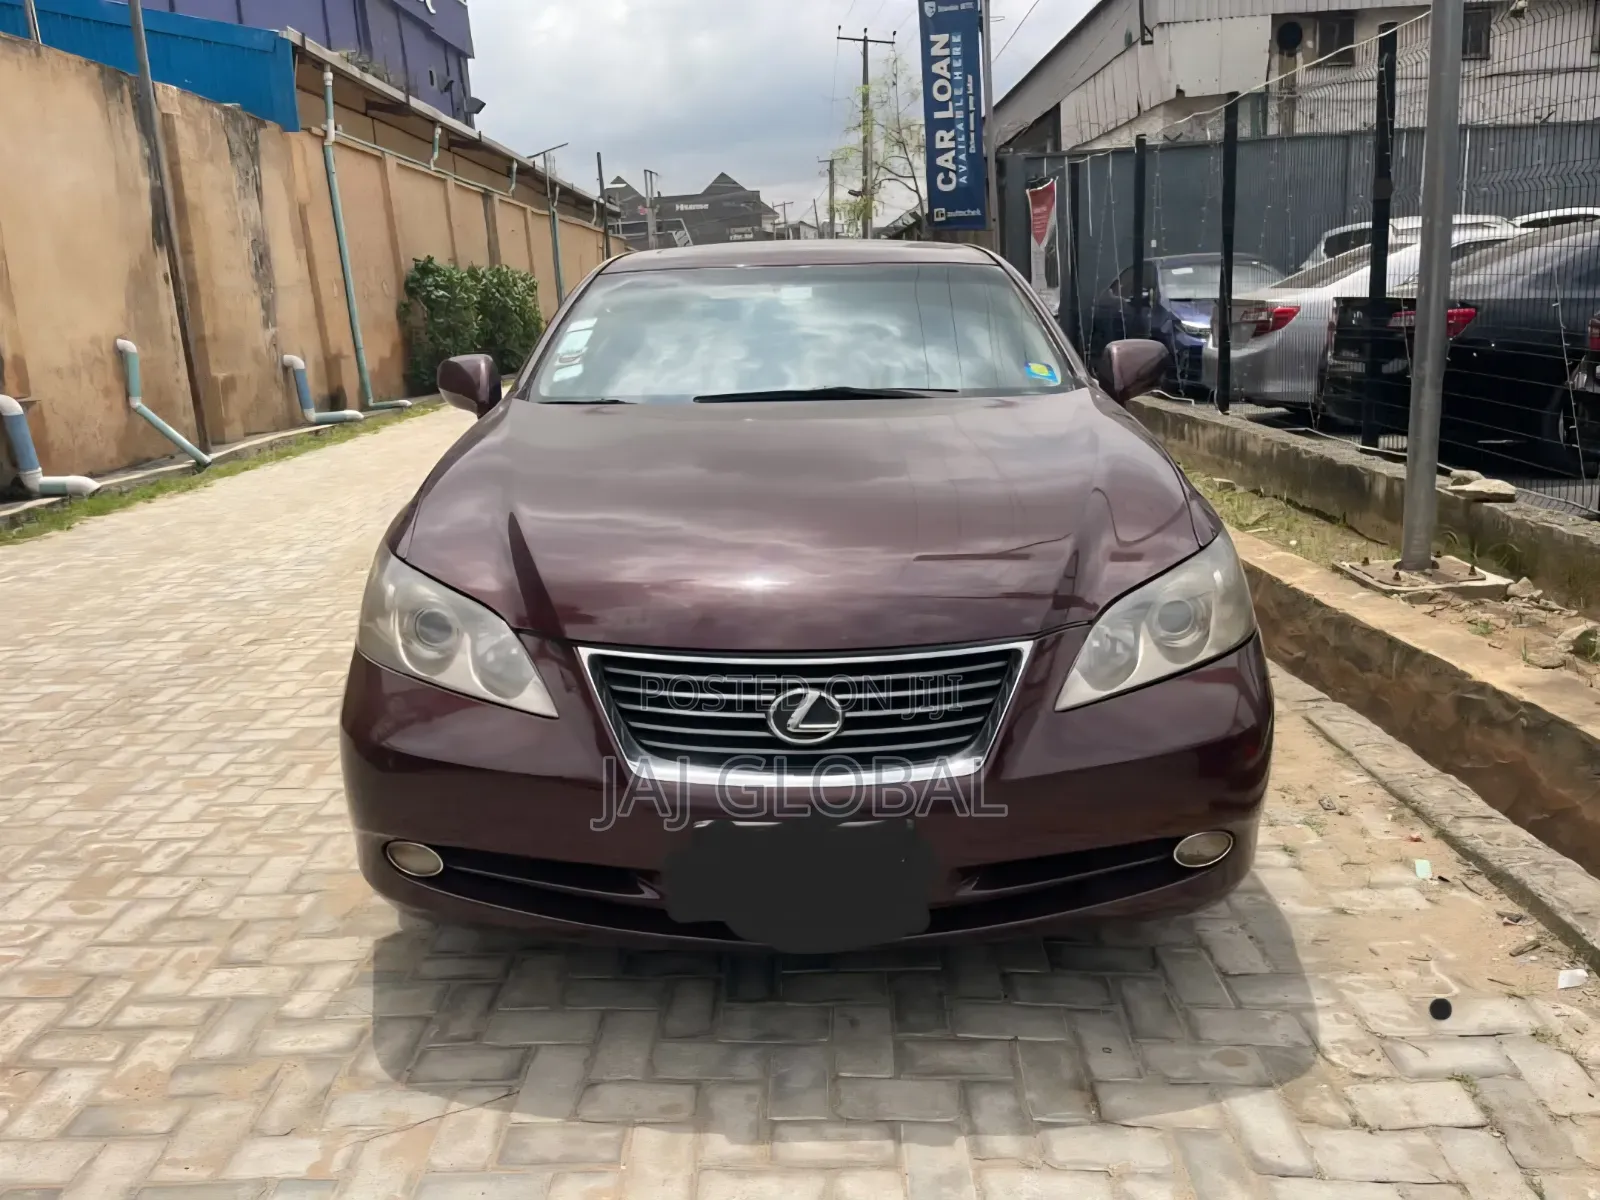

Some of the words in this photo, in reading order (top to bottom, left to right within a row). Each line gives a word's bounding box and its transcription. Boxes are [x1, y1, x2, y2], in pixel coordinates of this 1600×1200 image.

[929, 33, 954, 119] LOAN
[951, 34, 963, 79] HERE
[935, 129, 957, 192] CAR
[954, 86, 969, 184] AVAILABLE
